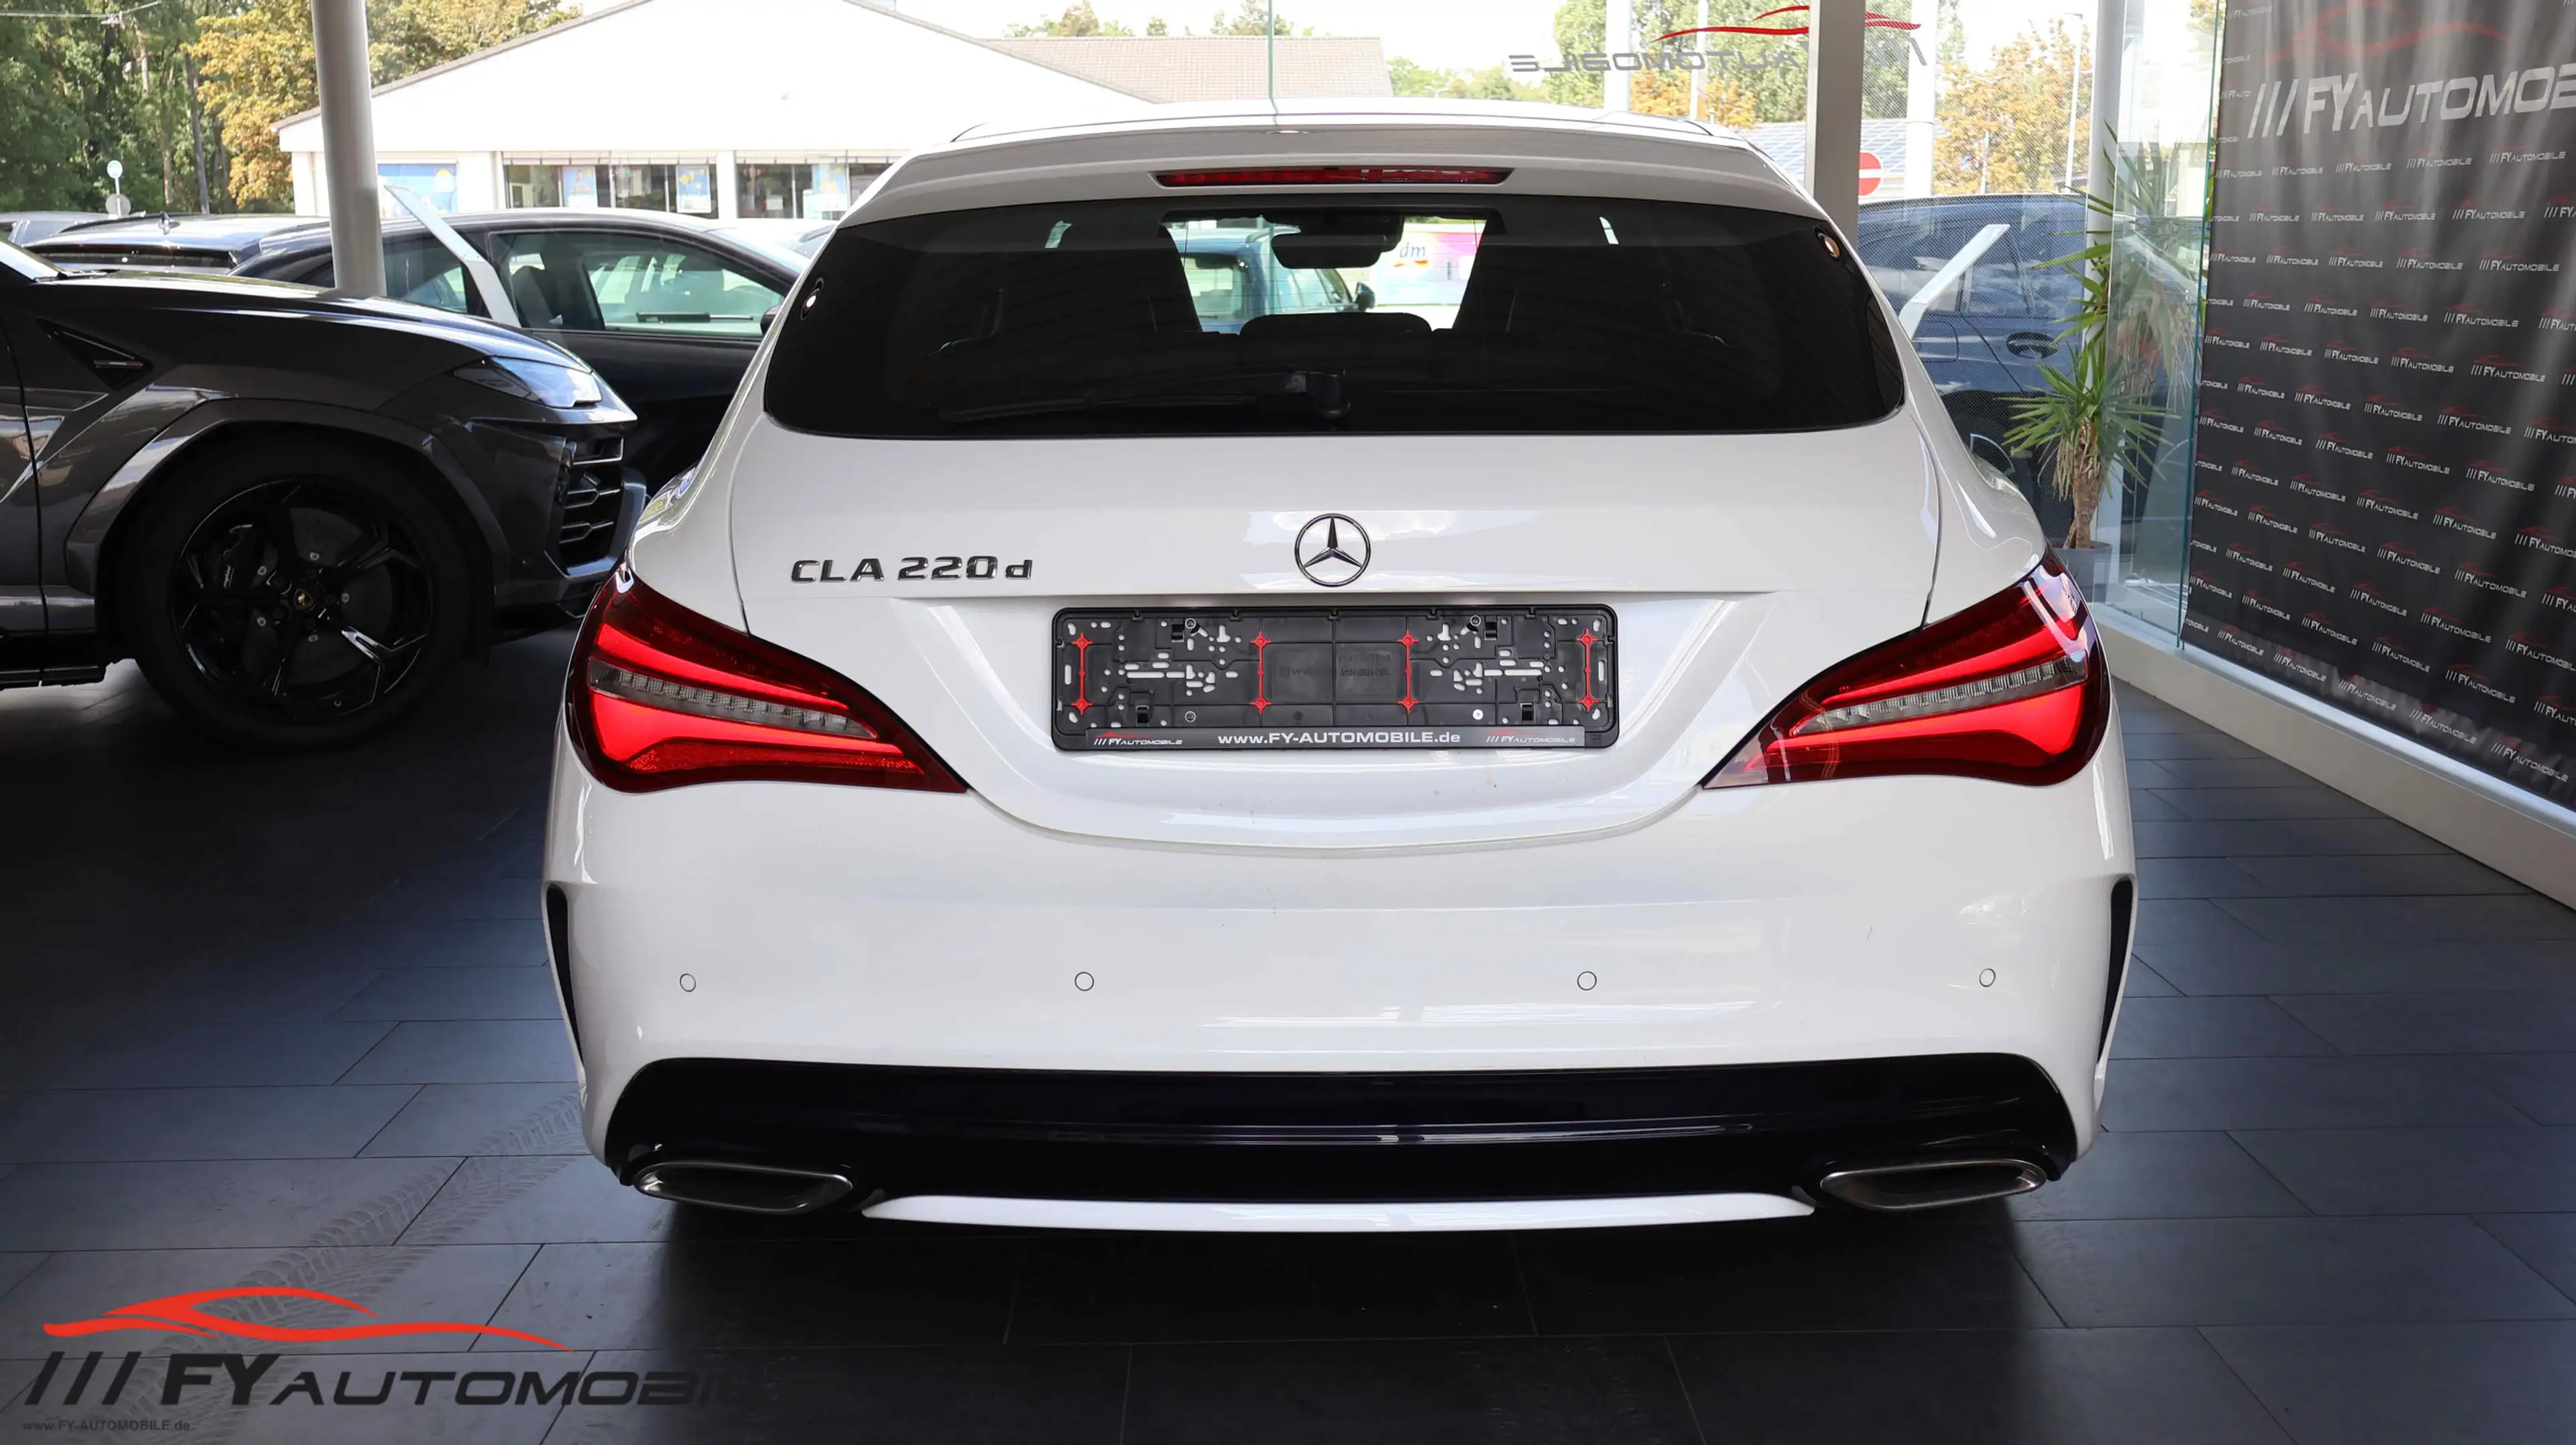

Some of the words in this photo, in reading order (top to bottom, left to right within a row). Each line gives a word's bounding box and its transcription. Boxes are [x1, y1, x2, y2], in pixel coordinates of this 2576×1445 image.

[791, 557, 884, 582] CLA
[898, 555, 998, 580] 220
[1005, 559, 1033, 580] d
[1218, 732, 1461, 744] www.FY-AUTOMOBILE.de
